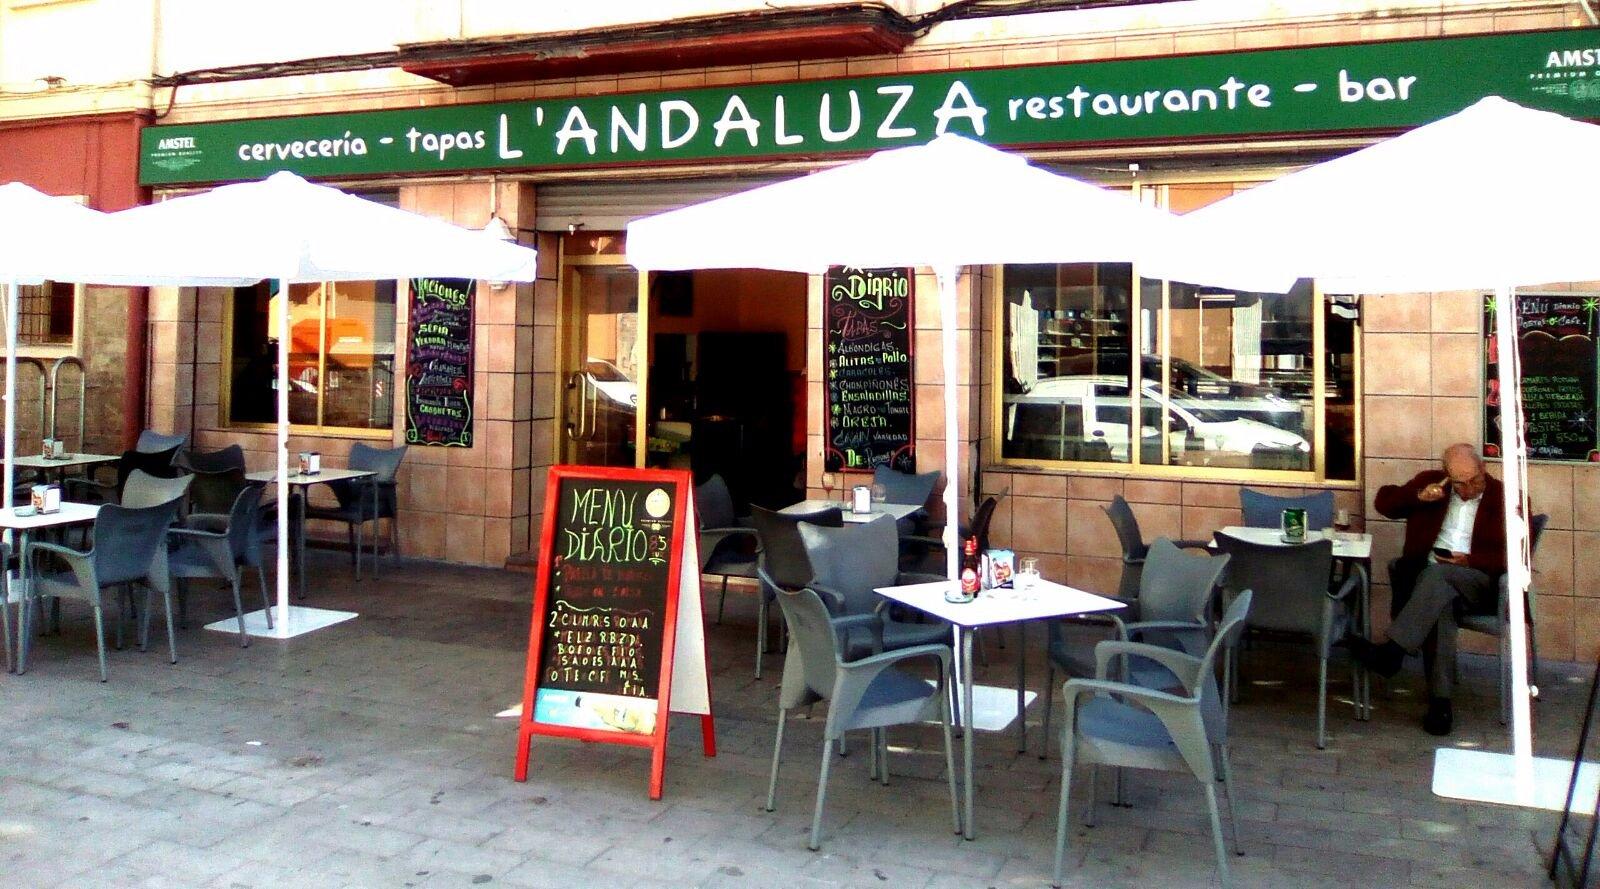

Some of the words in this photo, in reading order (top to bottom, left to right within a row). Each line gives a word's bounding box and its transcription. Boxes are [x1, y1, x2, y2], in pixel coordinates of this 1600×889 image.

[238, 130, 368, 162] cervecería
[406, 126, 487, 161] tapas
[498, 80, 988, 160] L'ANDALUZA
[1008, 76, 1272, 121] restaurante
[1338, 69, 1417, 103] bar
[158, 136, 196, 150] AMSTEL
[571, 488, 638, 527] MENU
[564, 526, 647, 563] DIARIO
